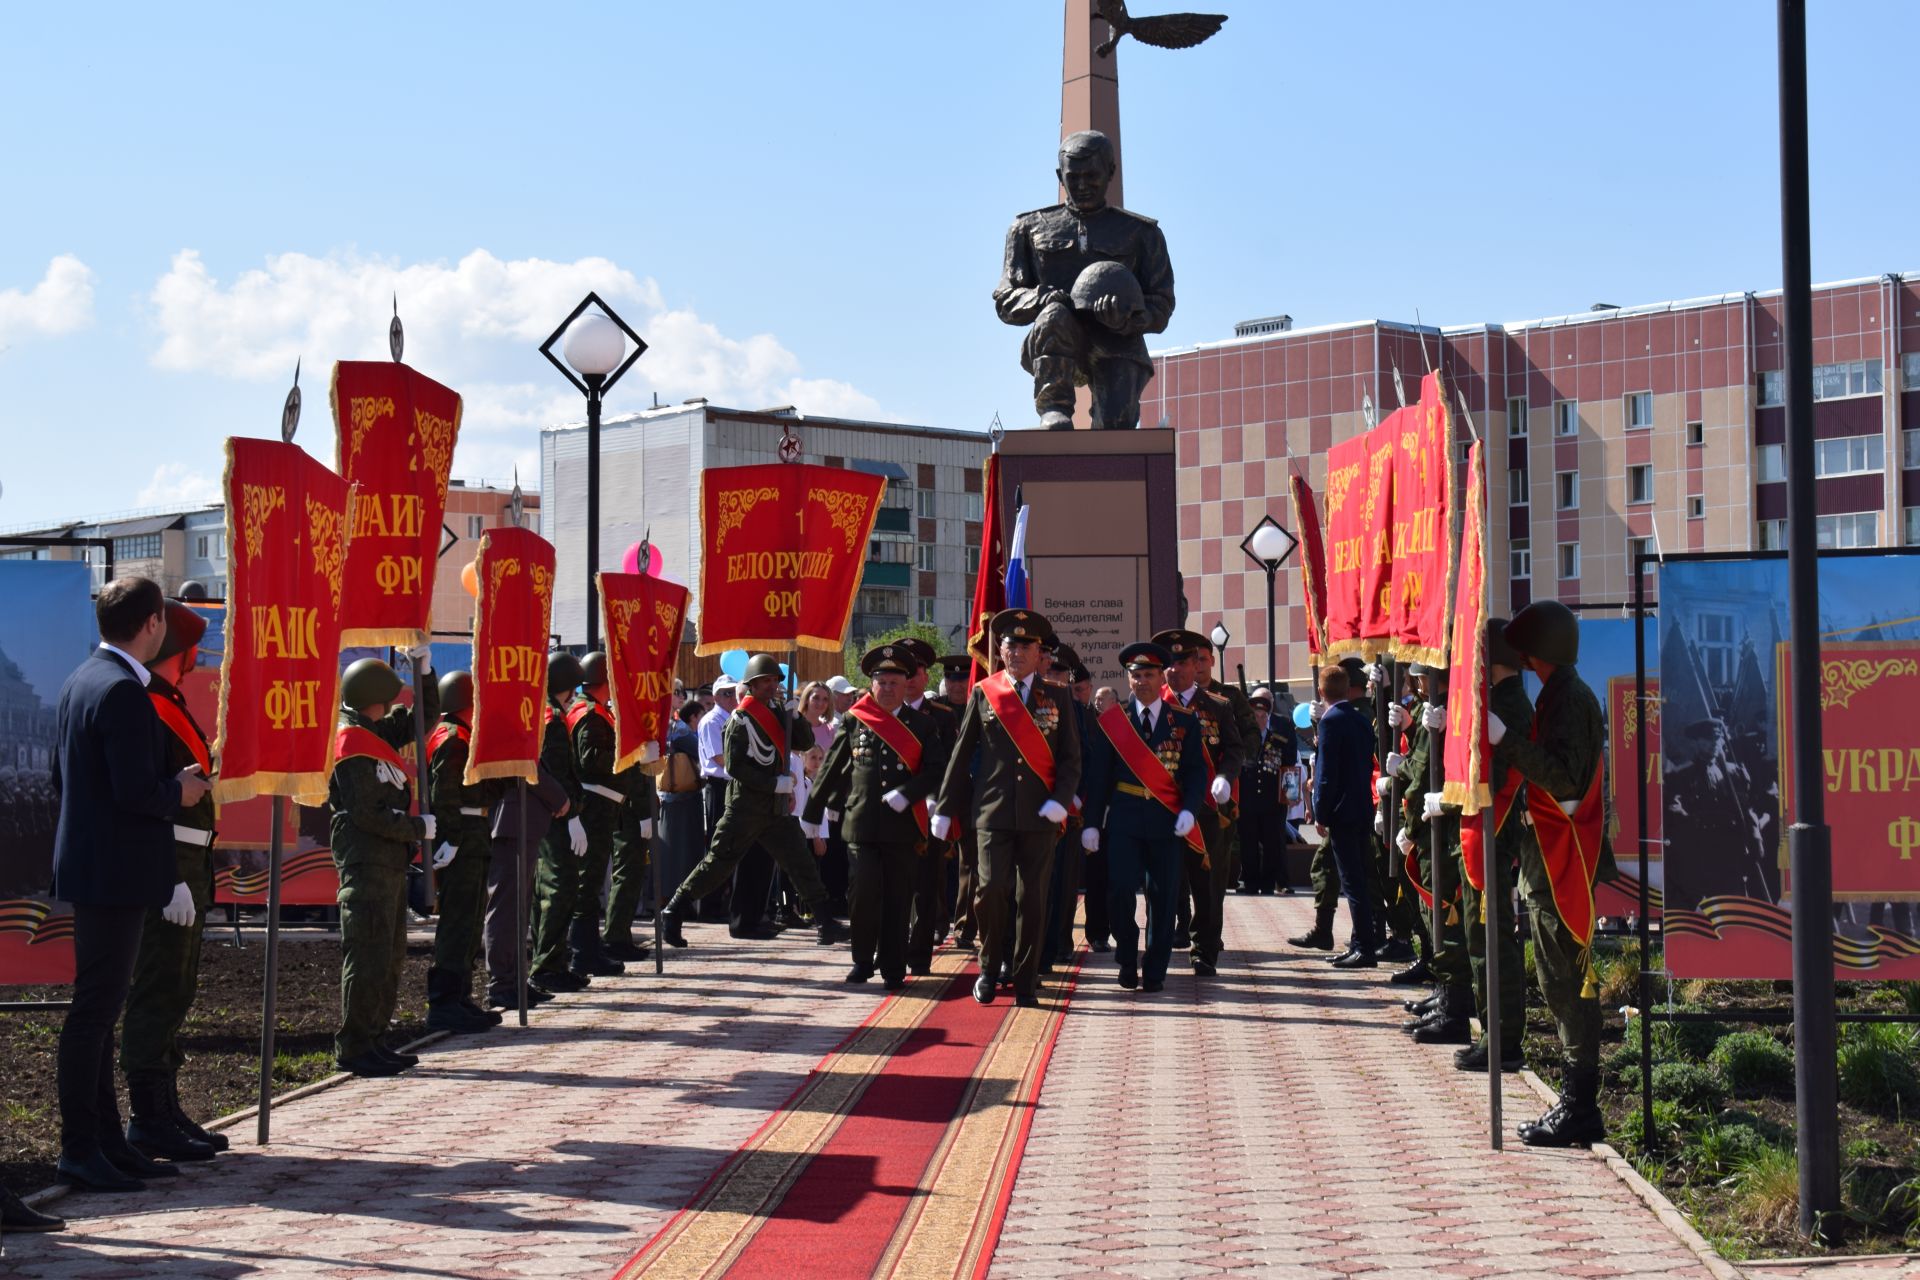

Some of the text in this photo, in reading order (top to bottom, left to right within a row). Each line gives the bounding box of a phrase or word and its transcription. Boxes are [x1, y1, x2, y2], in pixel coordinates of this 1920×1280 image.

[1044, 598, 1123, 608] Вечная слава
[1045, 612, 1123, 624] победителям!
